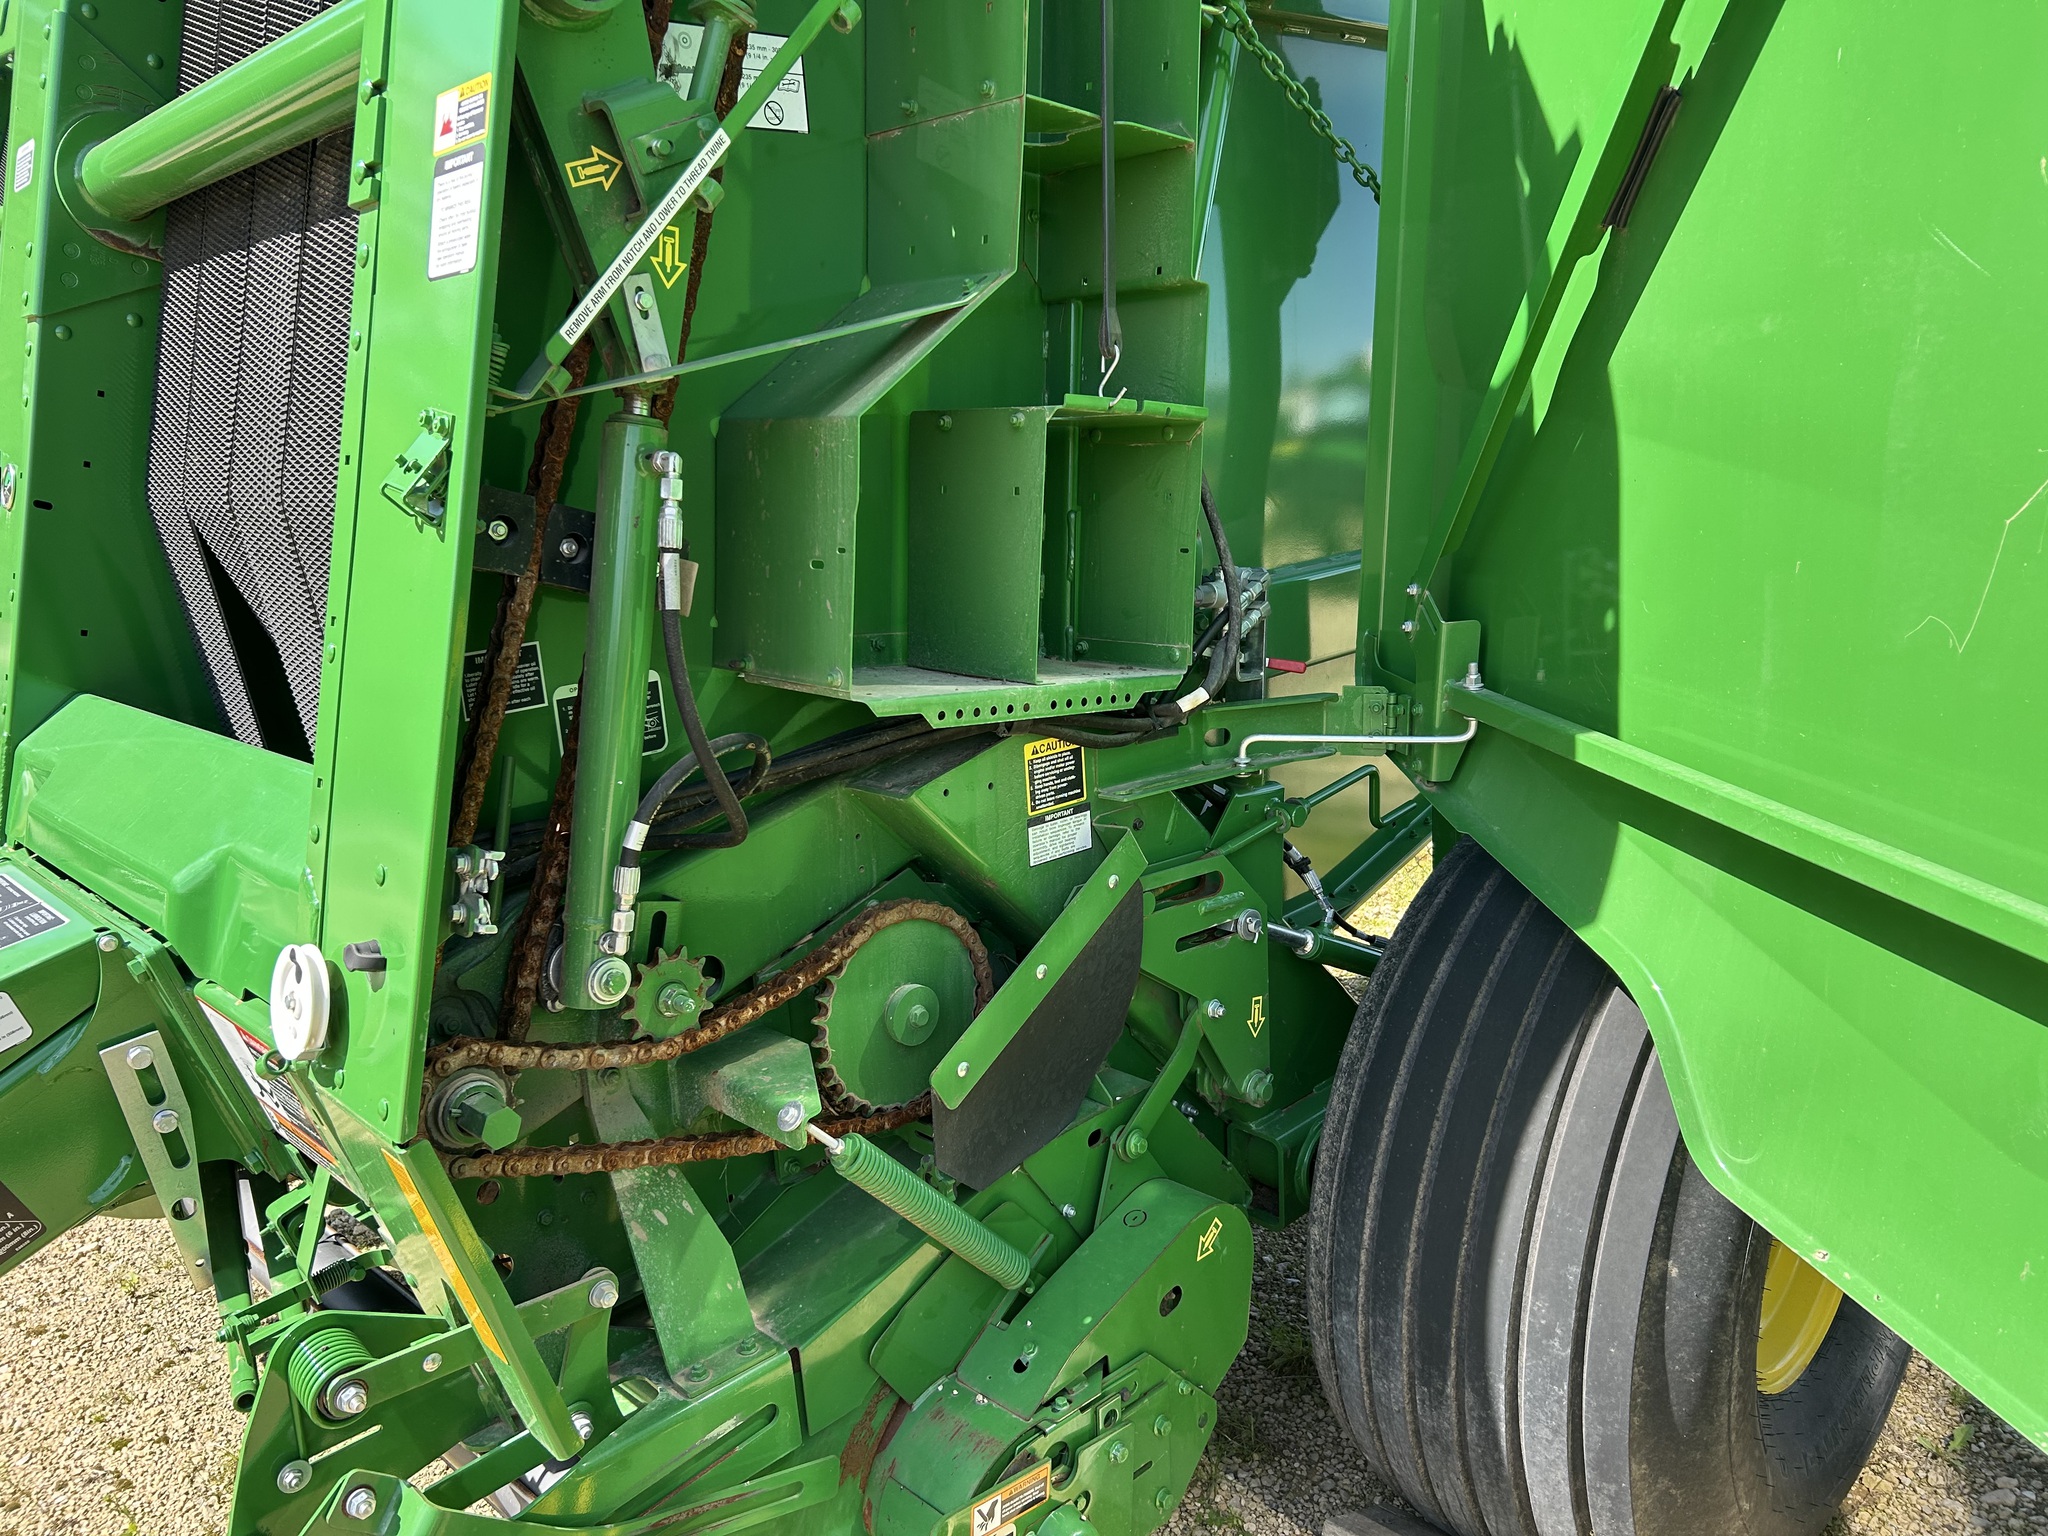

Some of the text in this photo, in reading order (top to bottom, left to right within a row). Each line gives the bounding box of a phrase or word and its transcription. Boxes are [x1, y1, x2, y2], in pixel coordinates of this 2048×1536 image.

[565, 134, 727, 339] REMOVE ARM FROM NOTCH AND LOWER TO THREAD TWINE
[1040, 739, 1073, 753] CAUTIO
[1045, 808, 1074, 821] IMPORTANT
[1013, 1474, 1040, 1493] WARNING
